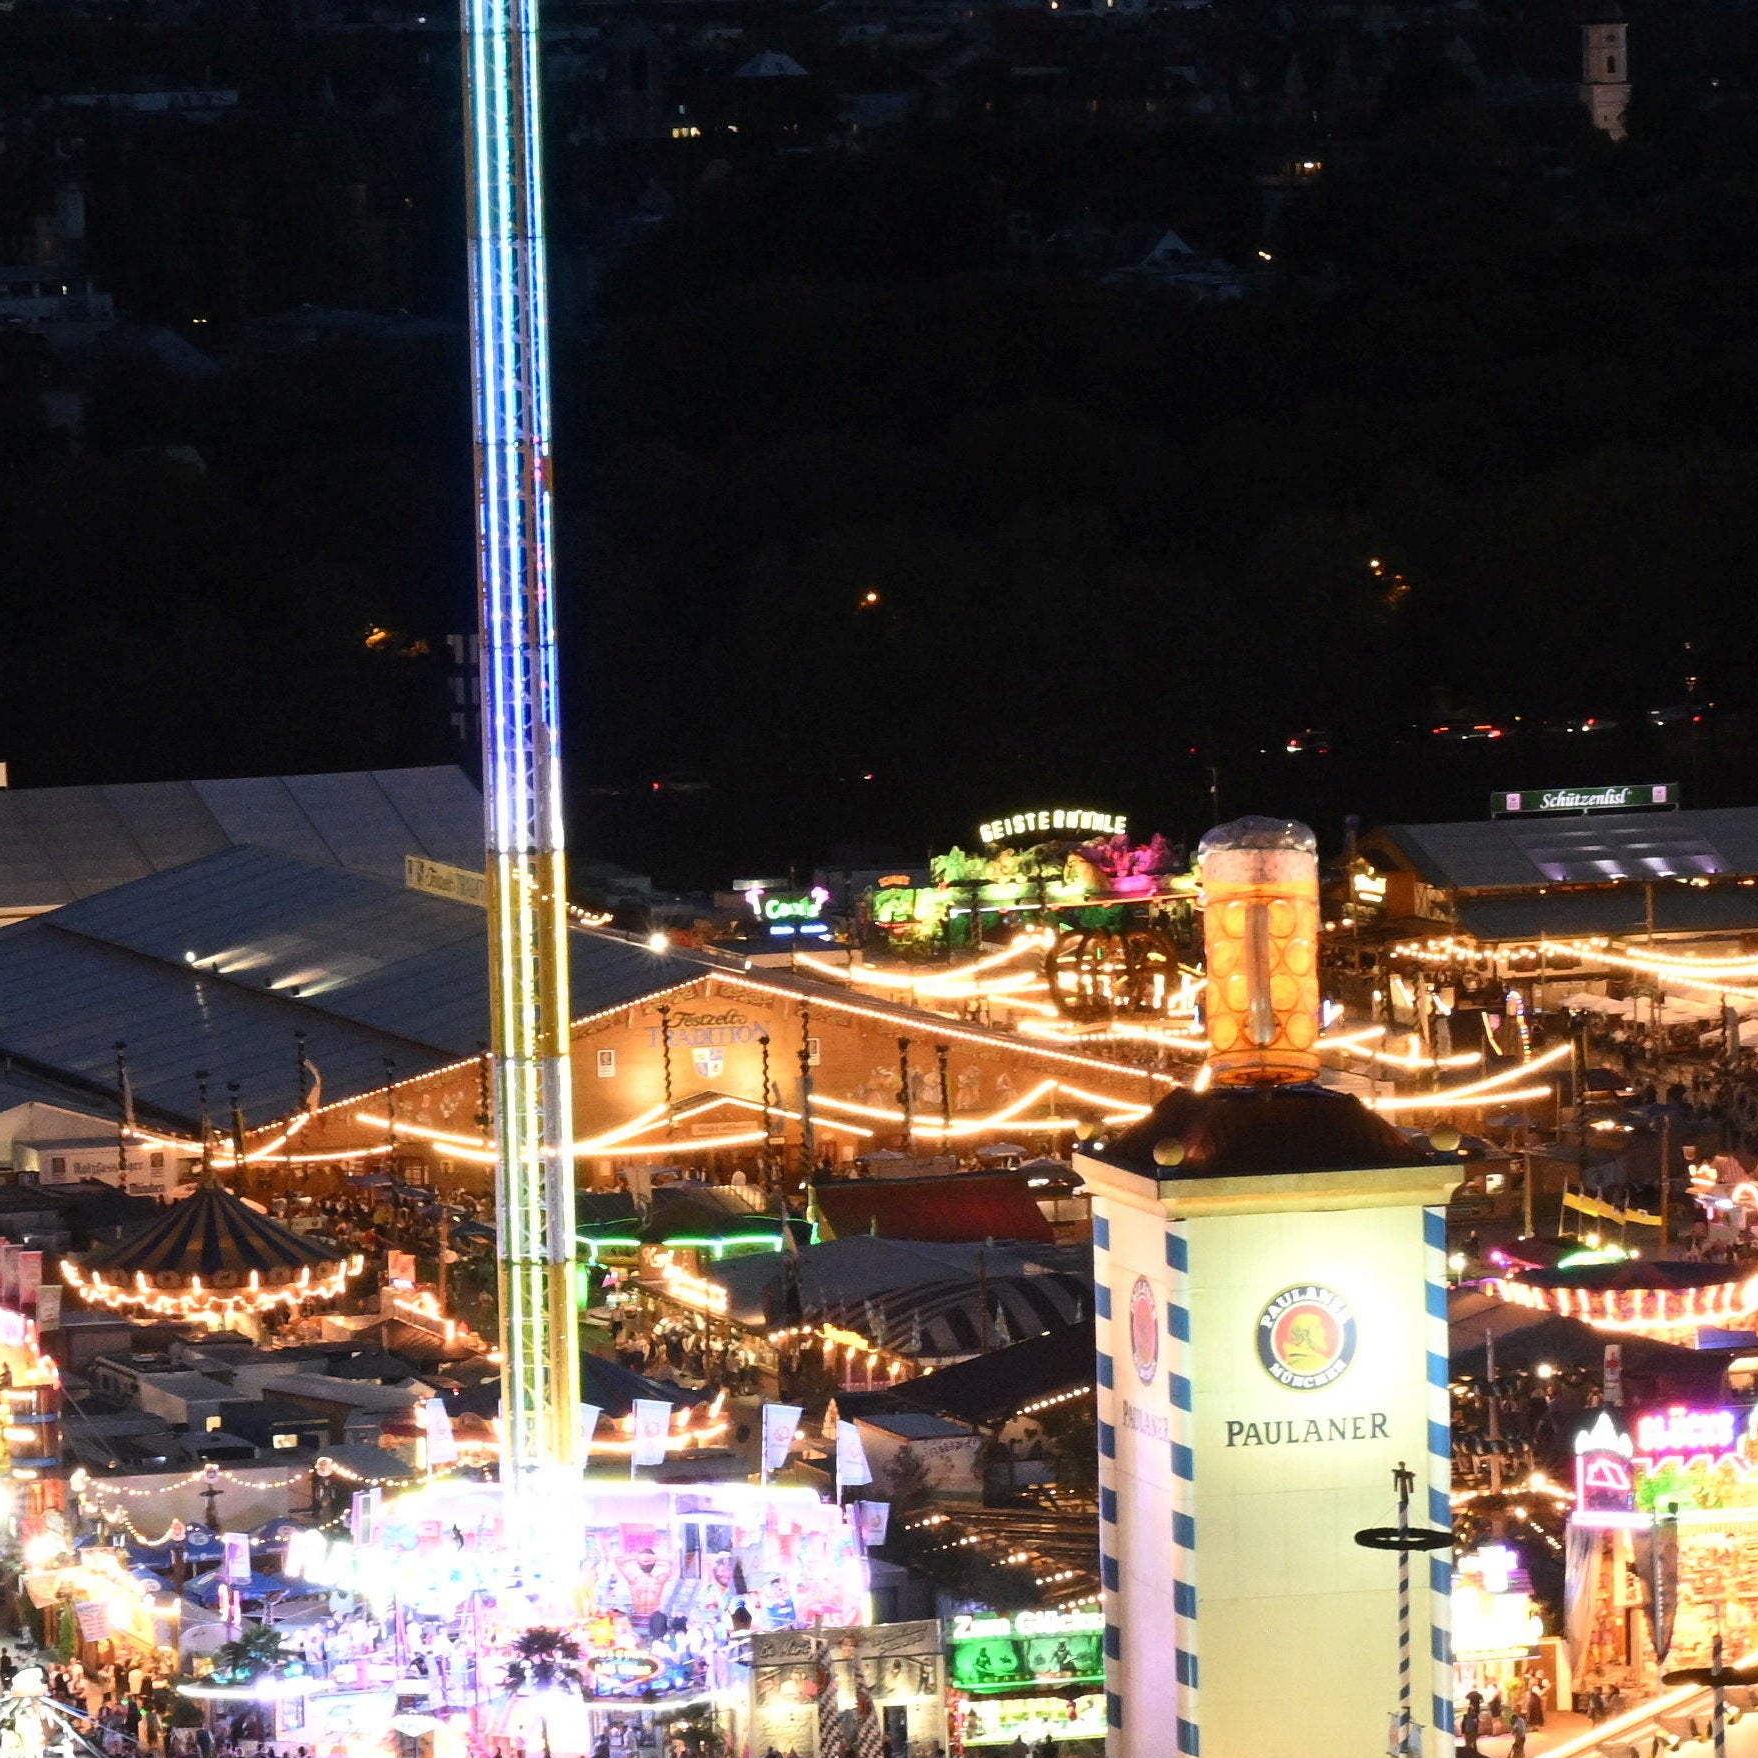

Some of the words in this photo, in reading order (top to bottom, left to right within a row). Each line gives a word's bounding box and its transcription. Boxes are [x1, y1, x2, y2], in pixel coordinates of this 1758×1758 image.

[1539, 787, 1630, 810] Schützenlisl
[1260, 1286, 1354, 1329] PAULANER
[1225, 1412, 1391, 1448] PAULANER
